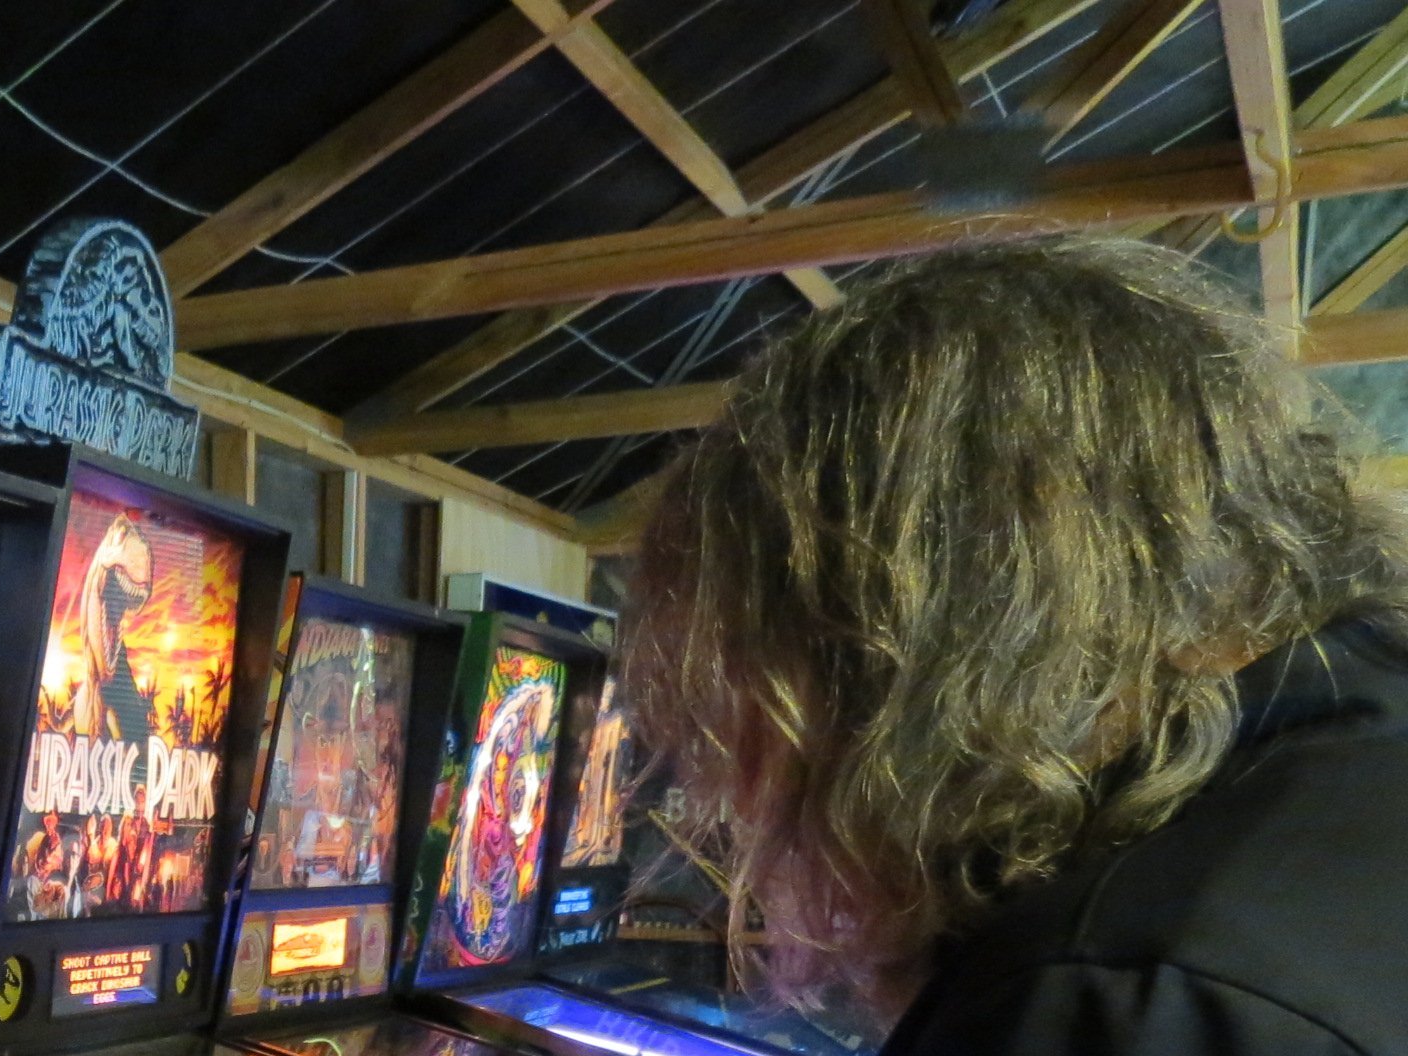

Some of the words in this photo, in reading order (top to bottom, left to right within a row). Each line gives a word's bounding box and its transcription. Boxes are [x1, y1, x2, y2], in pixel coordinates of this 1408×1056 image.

[21, 732, 139, 815] URASSIC
[144, 735, 219, 828] PARK
[61, 956, 92, 970] SHOOT
[94, 952, 129, 967] CAPTIVE
[130, 950, 152, 963] BALL
[132, 963, 144, 975] TO
